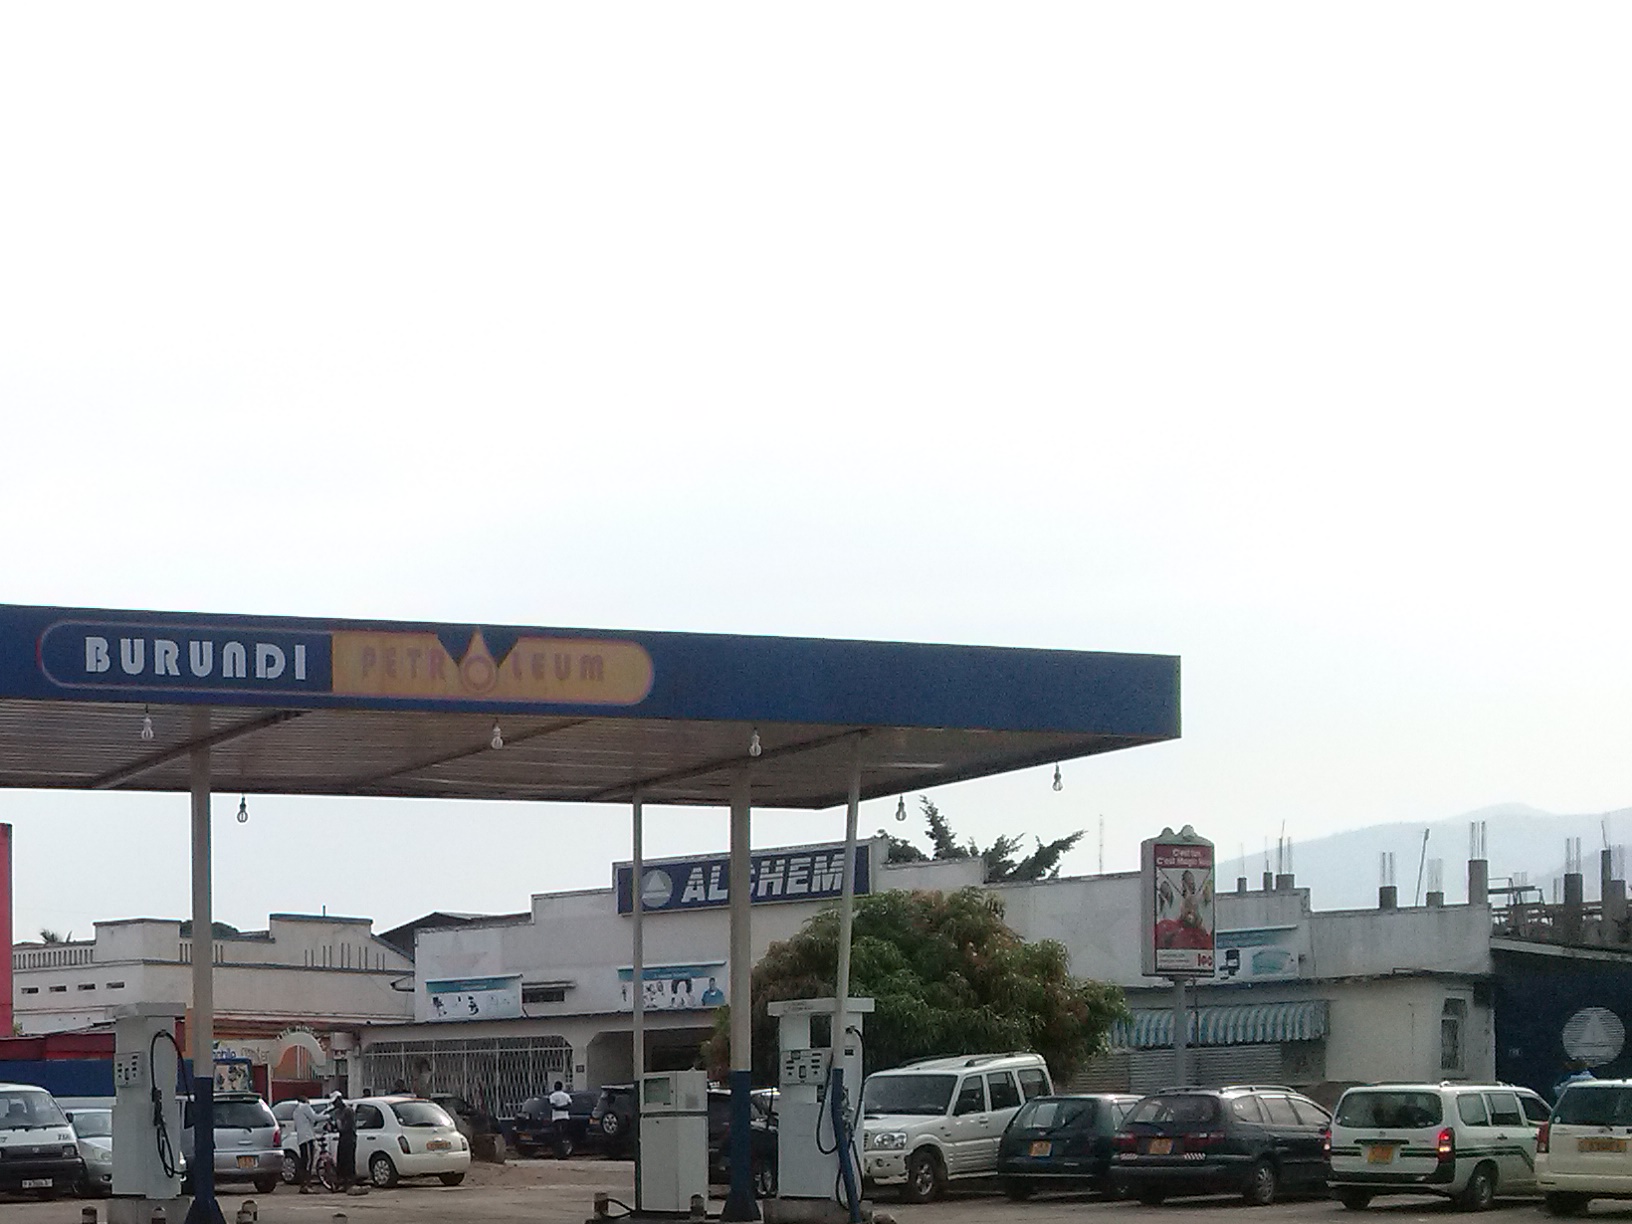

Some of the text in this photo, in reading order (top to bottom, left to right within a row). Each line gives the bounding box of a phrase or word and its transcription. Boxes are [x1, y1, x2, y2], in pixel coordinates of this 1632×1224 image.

[85, 636, 604, 691] BURUNDI PETROLEUM
[681, 853, 845, 903] ALHEM
